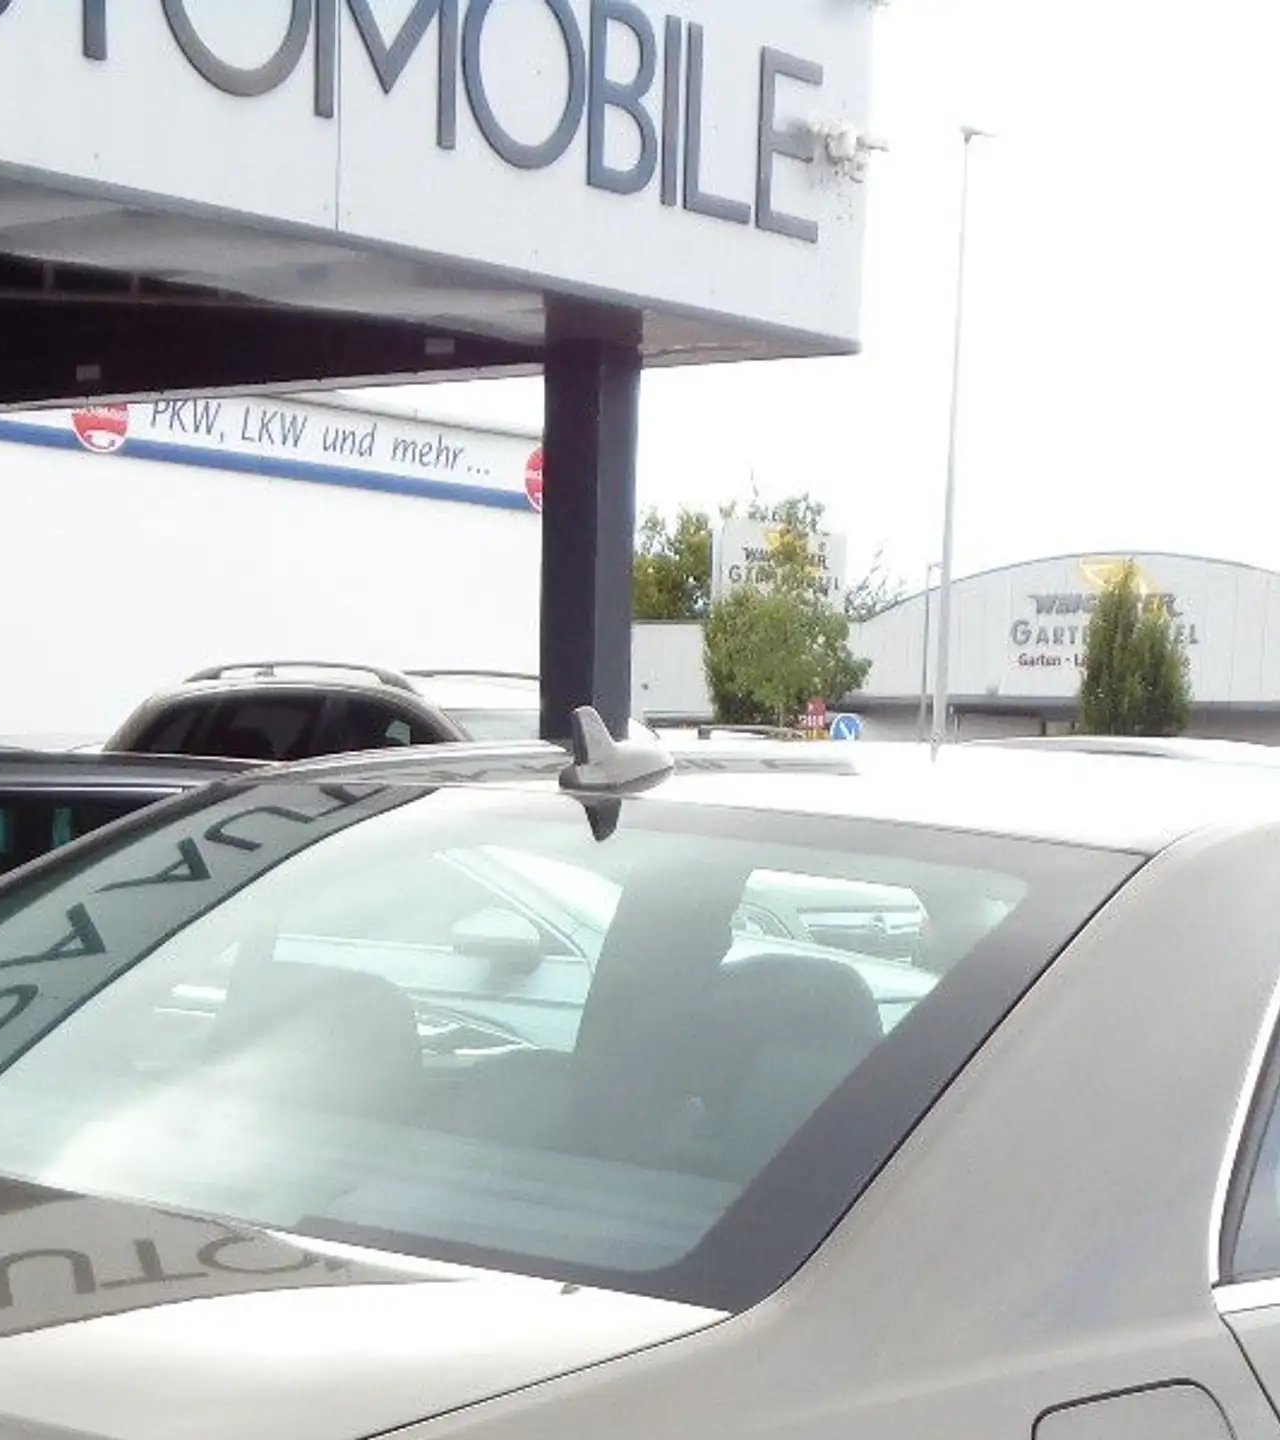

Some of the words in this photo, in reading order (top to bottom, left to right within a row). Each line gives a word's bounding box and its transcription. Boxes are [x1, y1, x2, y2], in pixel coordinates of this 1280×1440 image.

[150, 400, 224, 443] PKW,
[241, 405, 307, 448] LKW
[322, 423, 377, 458] und
[390, 435, 490, 476] mehr...
